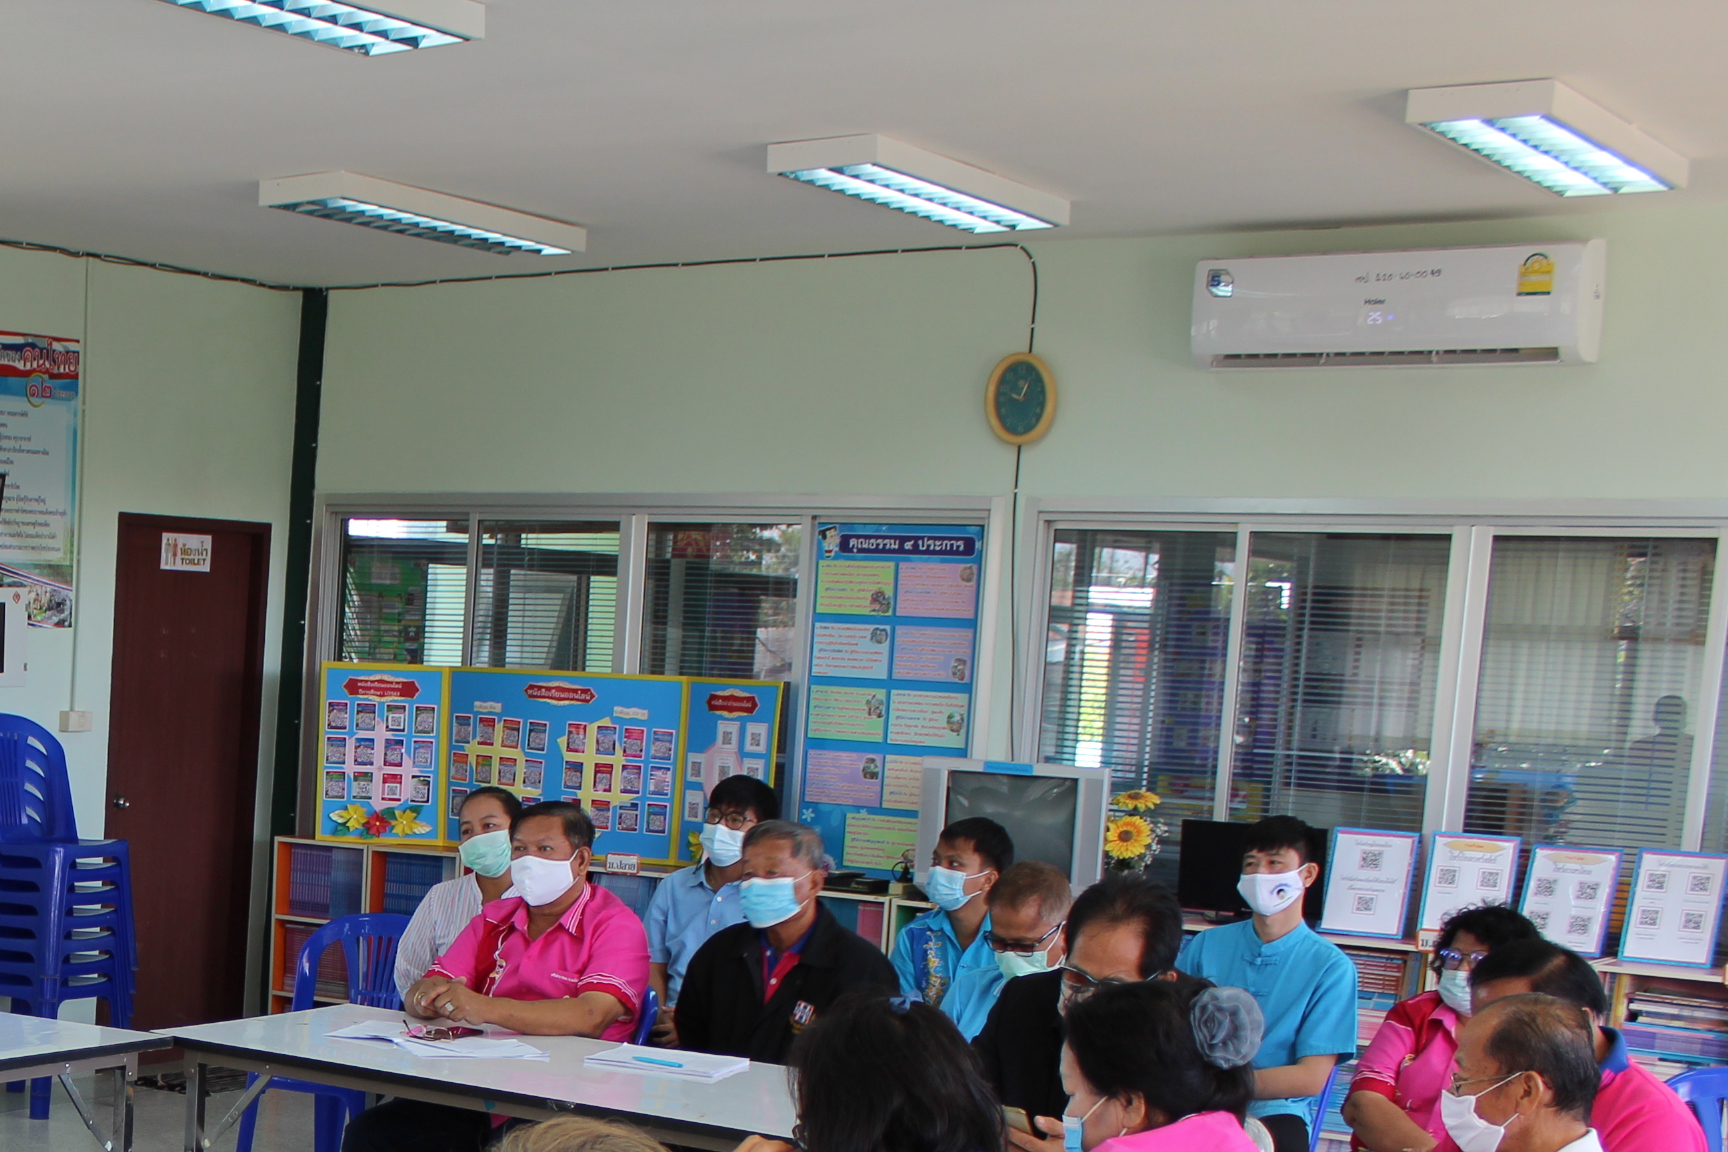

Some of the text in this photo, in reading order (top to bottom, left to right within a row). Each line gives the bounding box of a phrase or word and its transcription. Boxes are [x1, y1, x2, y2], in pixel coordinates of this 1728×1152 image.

[1366, 311, 1383, 325] 25
[849, 538, 898, 553] คุณธรรม
[918, 537, 965, 551] ประการ
[180, 557, 206, 566] TOILET
